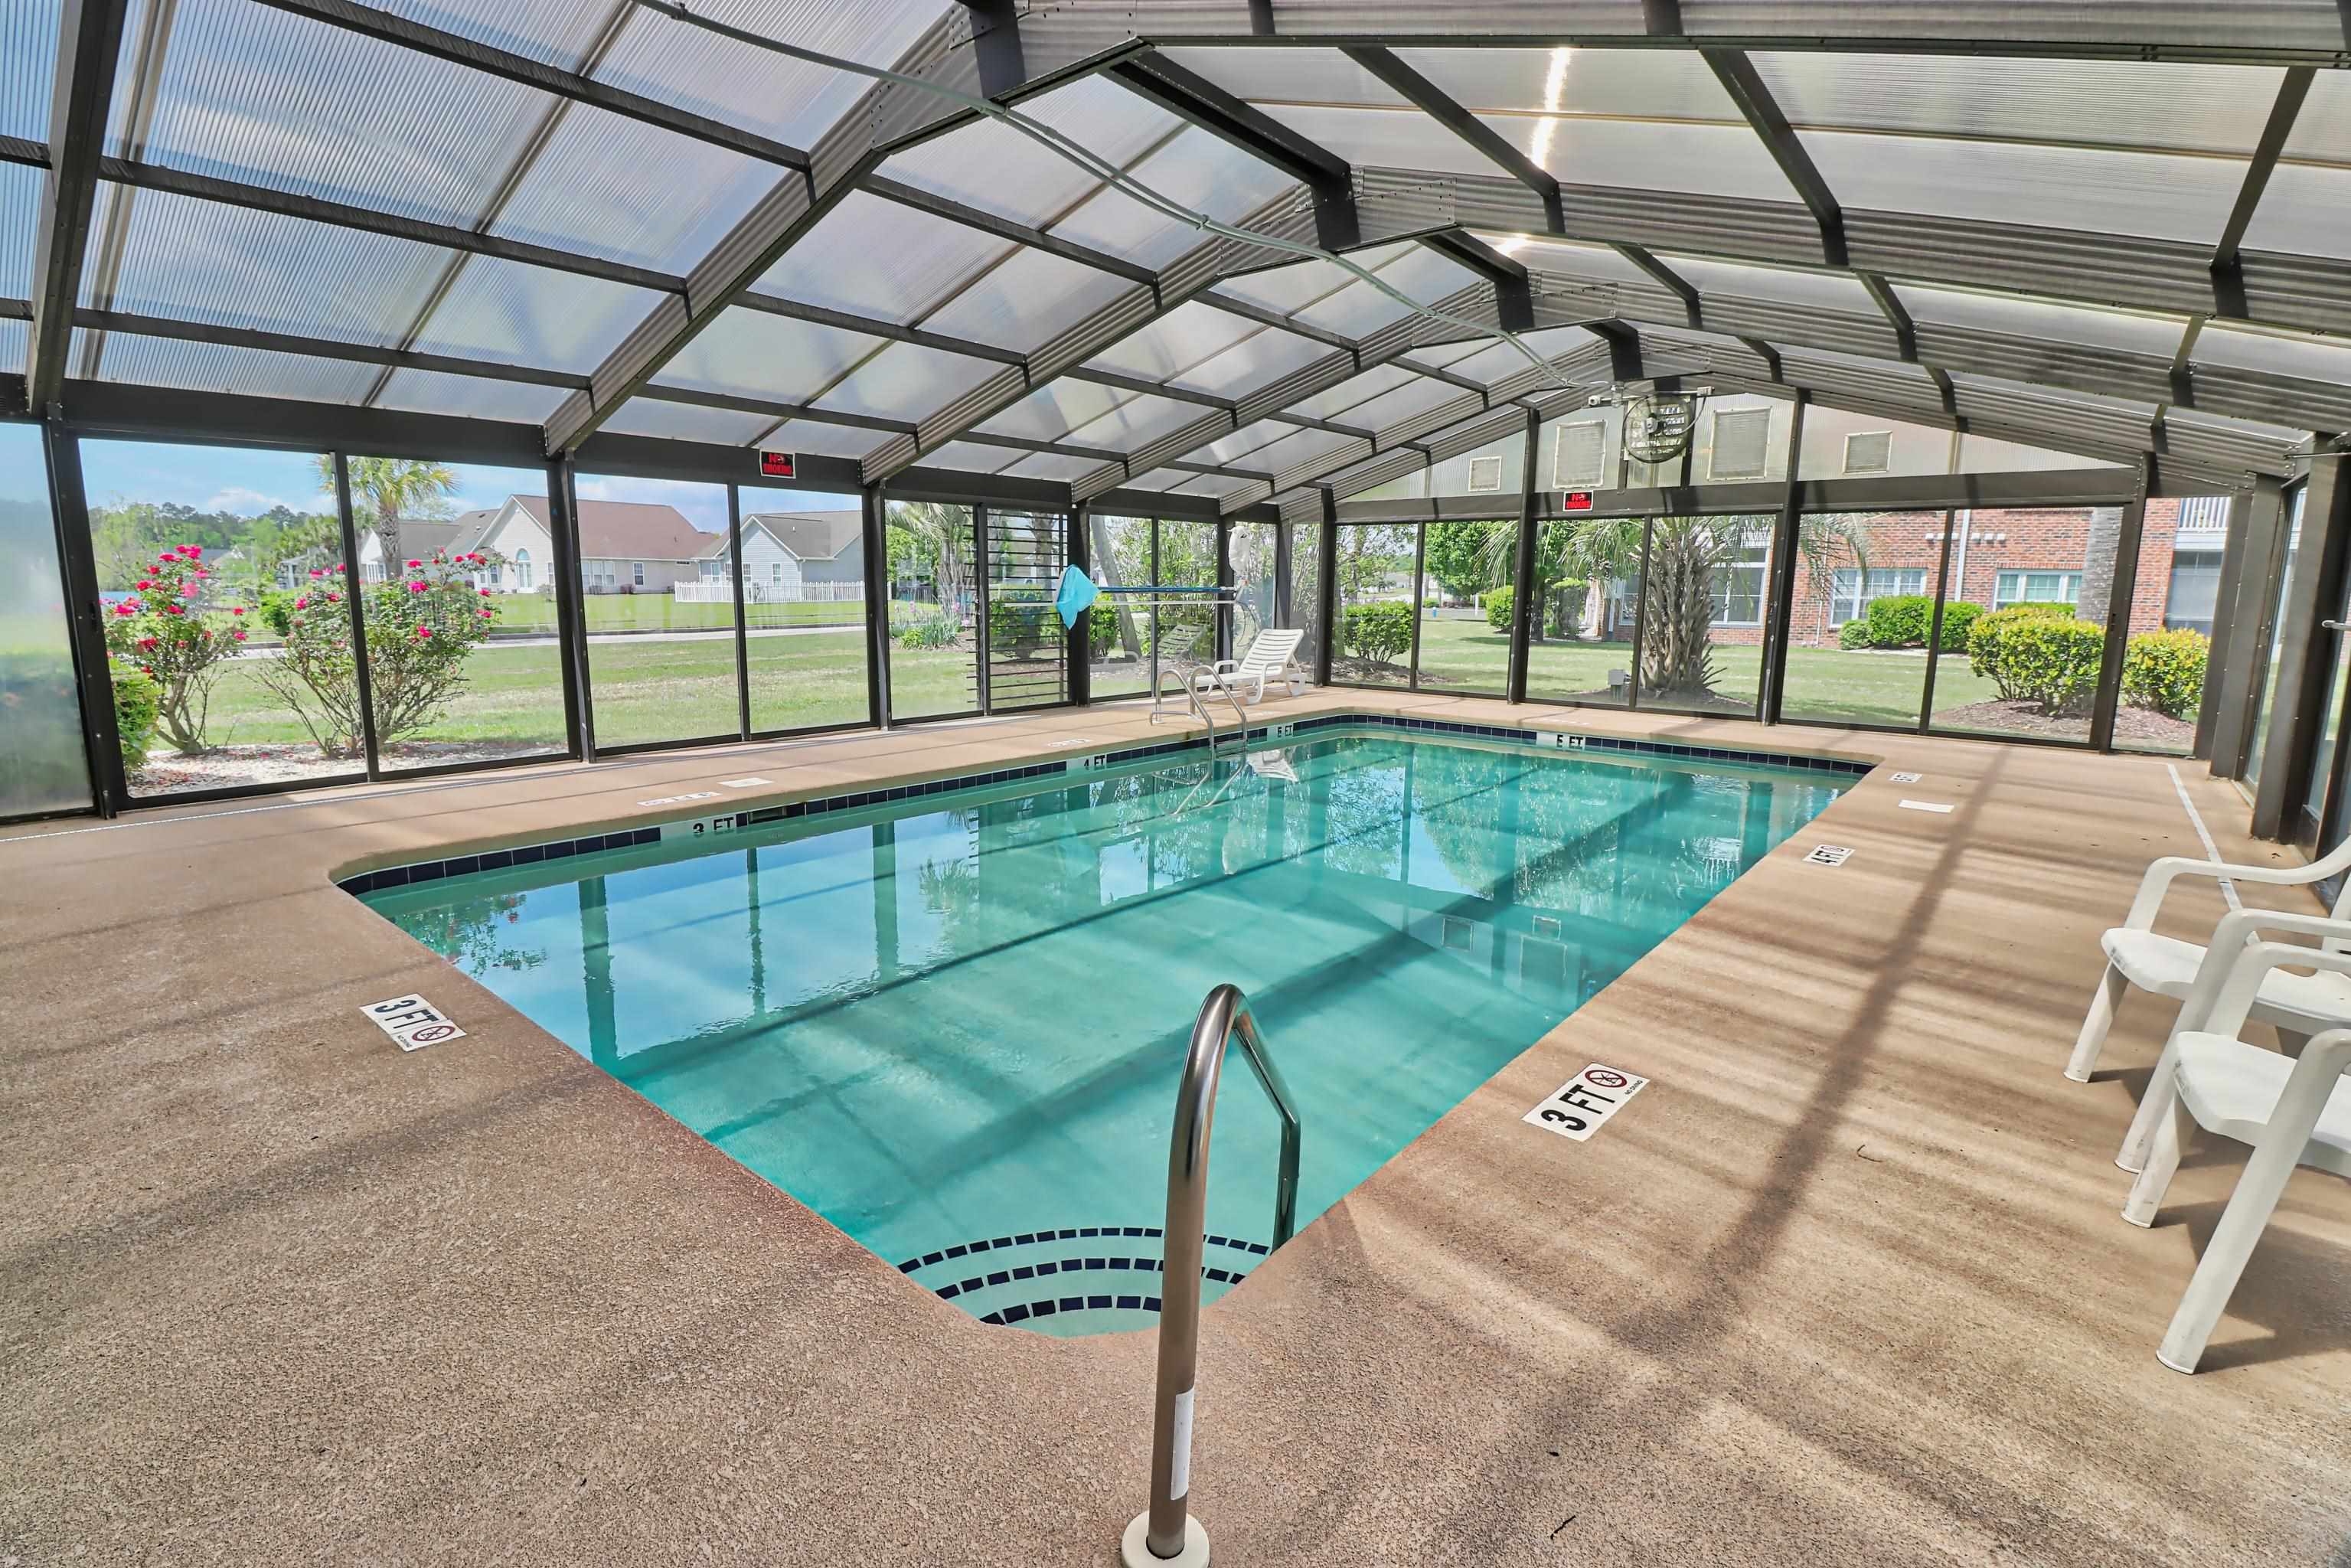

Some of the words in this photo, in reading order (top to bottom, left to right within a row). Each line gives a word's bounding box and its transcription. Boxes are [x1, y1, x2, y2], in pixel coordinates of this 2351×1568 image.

[1569, 736, 1583, 746] FT
[1094, 755, 1105, 766] FT
[693, 822, 704, 834] 3
[713, 817, 734, 831] FT
[1815, 850, 1844, 860] FT
[374, 999, 417, 1014] 3
[384, 1008, 439, 1029] FT
[1558, 1083, 1615, 1115] FT
[1540, 1109, 1587, 1132] 3
